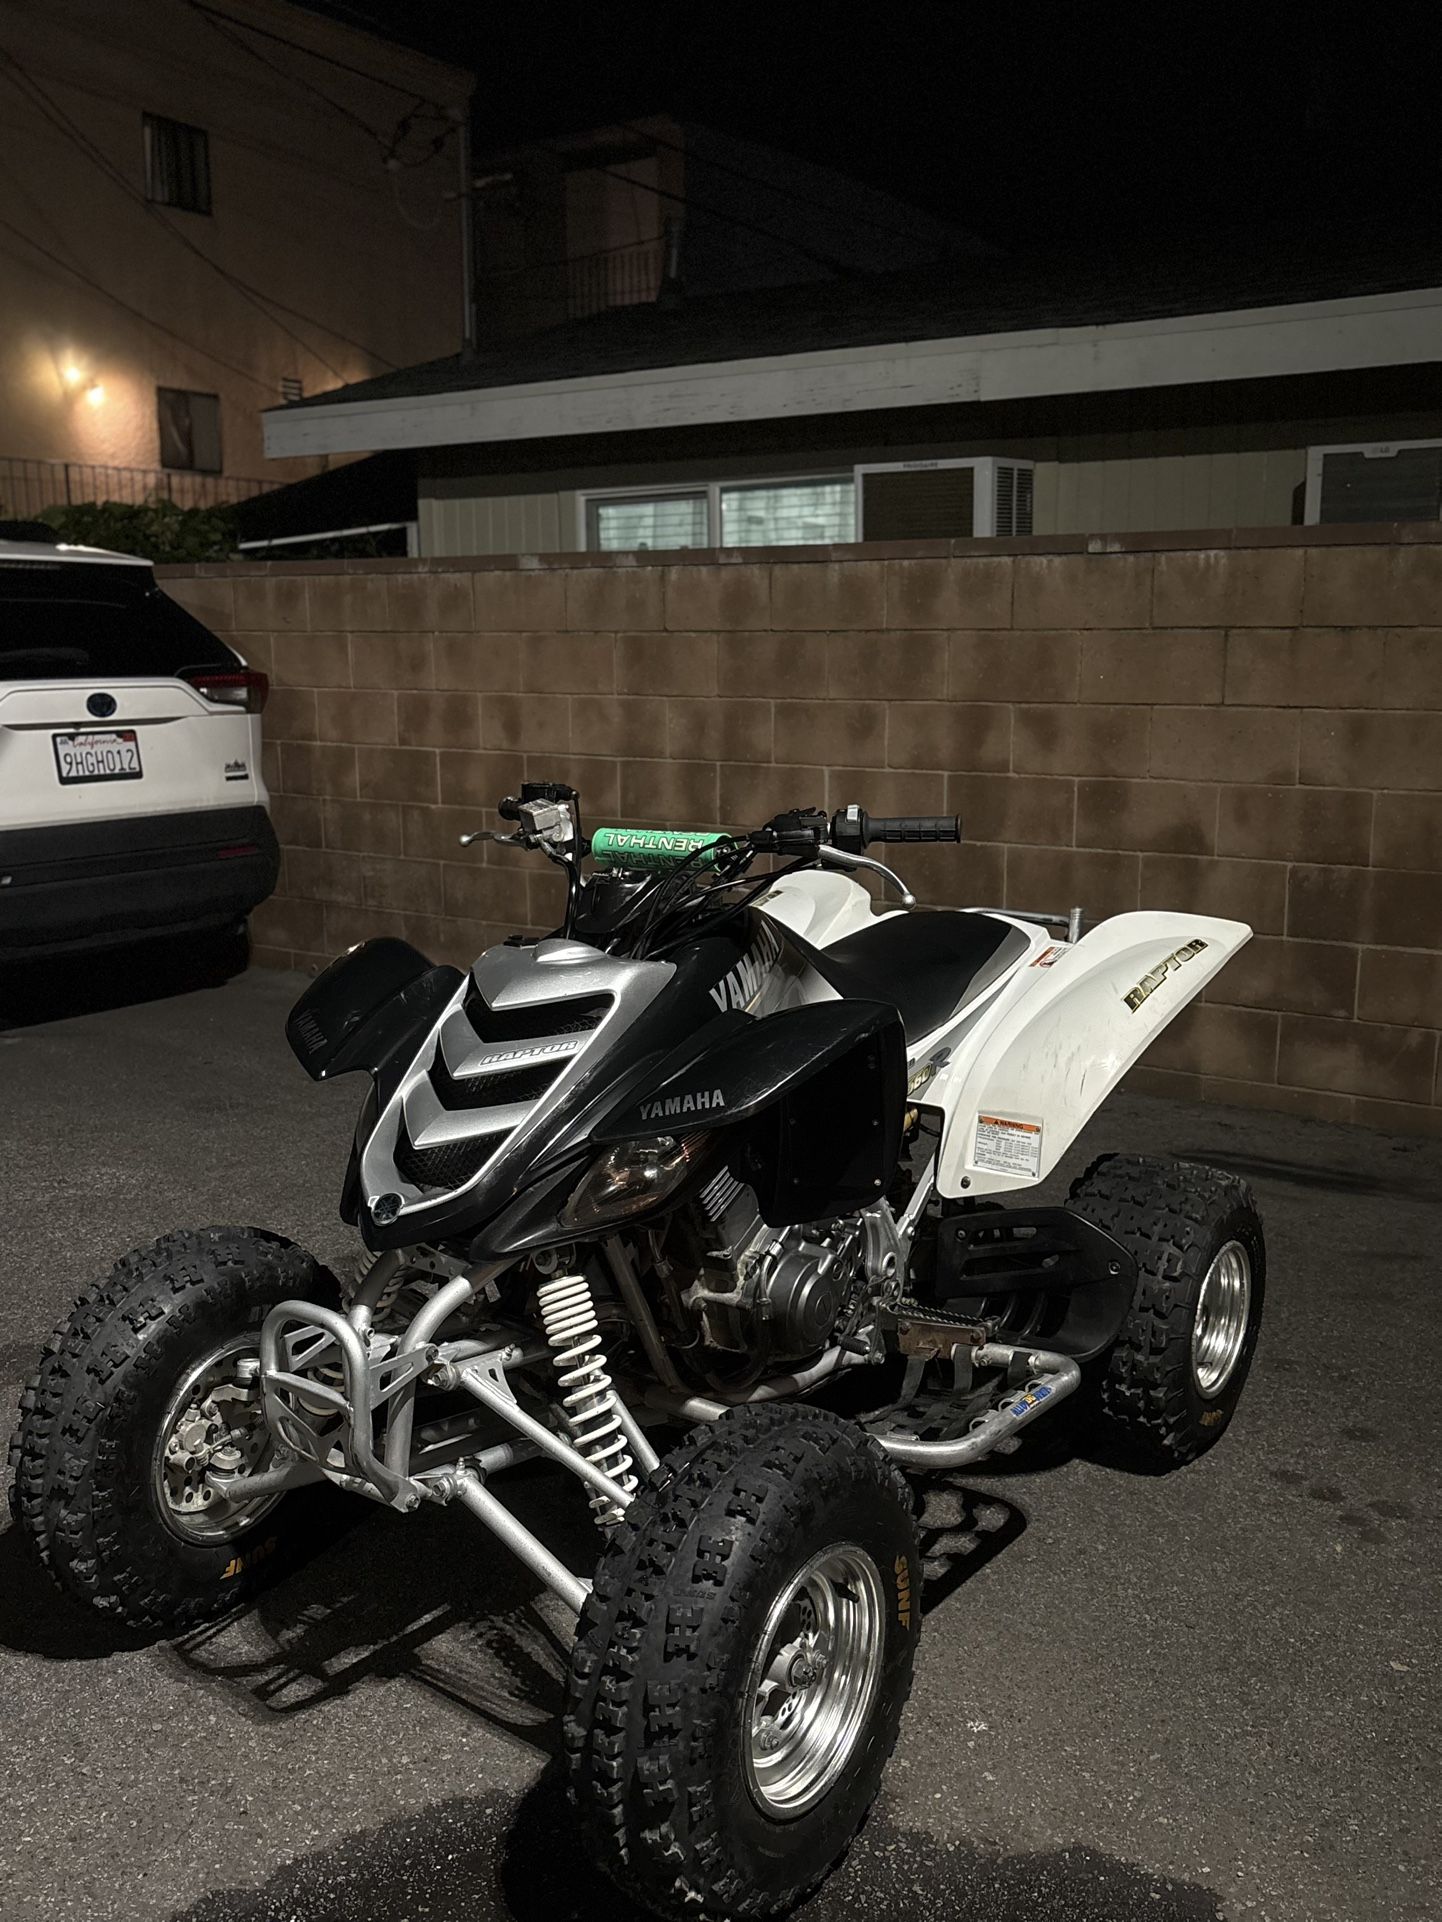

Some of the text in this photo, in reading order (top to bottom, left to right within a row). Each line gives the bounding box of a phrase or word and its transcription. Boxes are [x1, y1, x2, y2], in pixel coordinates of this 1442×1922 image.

[72, 735, 120, 750] California
[63, 748, 137, 776] 9HGH012
[604, 833, 705, 852] RENTHAL
[708, 919, 780, 1013] YAMAHA
[1121, 938, 1209, 1014] RAPTOR
[480, 1040, 578, 1066] RAPTOR
[639, 1088, 725, 1120] YAMAHA
[894, 1553, 910, 1631] SUNF
